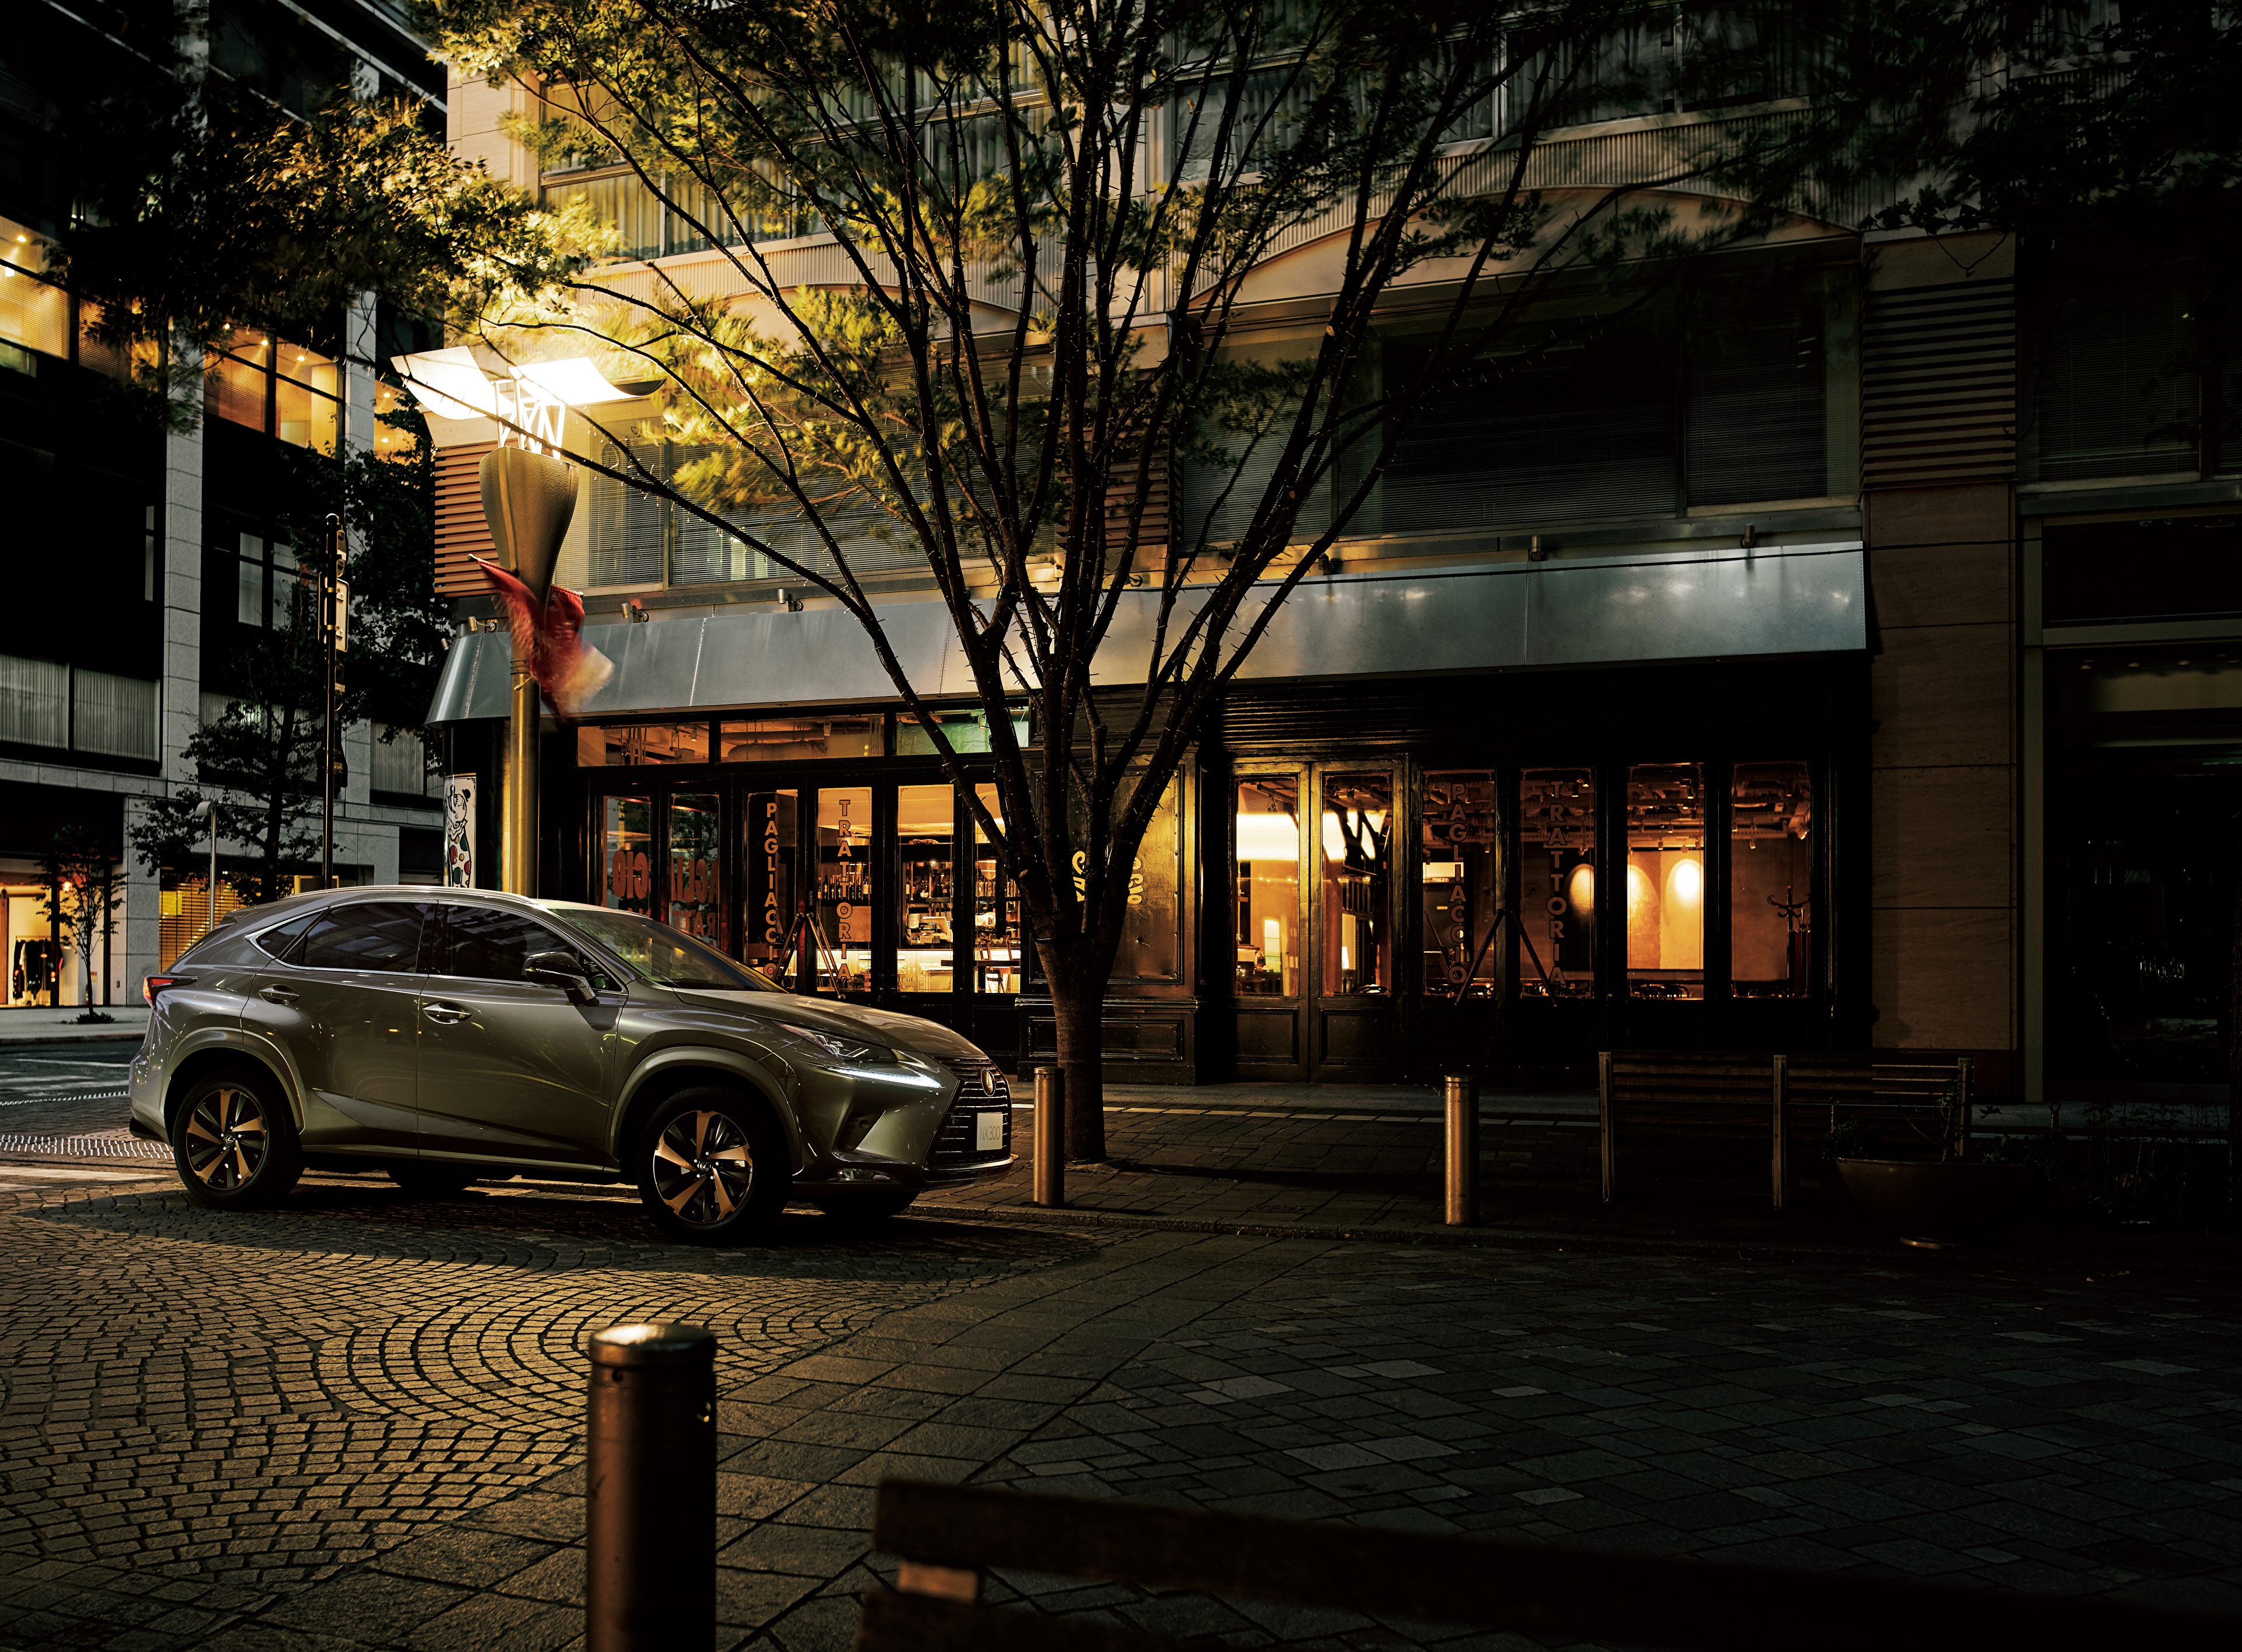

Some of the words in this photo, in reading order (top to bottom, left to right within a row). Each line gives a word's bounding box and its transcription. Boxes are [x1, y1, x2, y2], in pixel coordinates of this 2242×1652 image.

[764, 802, 779, 979] PAGLIACCIO
[837, 800, 852, 980] TRATTORIA
[1448, 783, 1467, 984] PAGLIACCIO
[1547, 781, 1566, 984] TRATTORIA
[979, 1126, 1000, 1140] NX300
